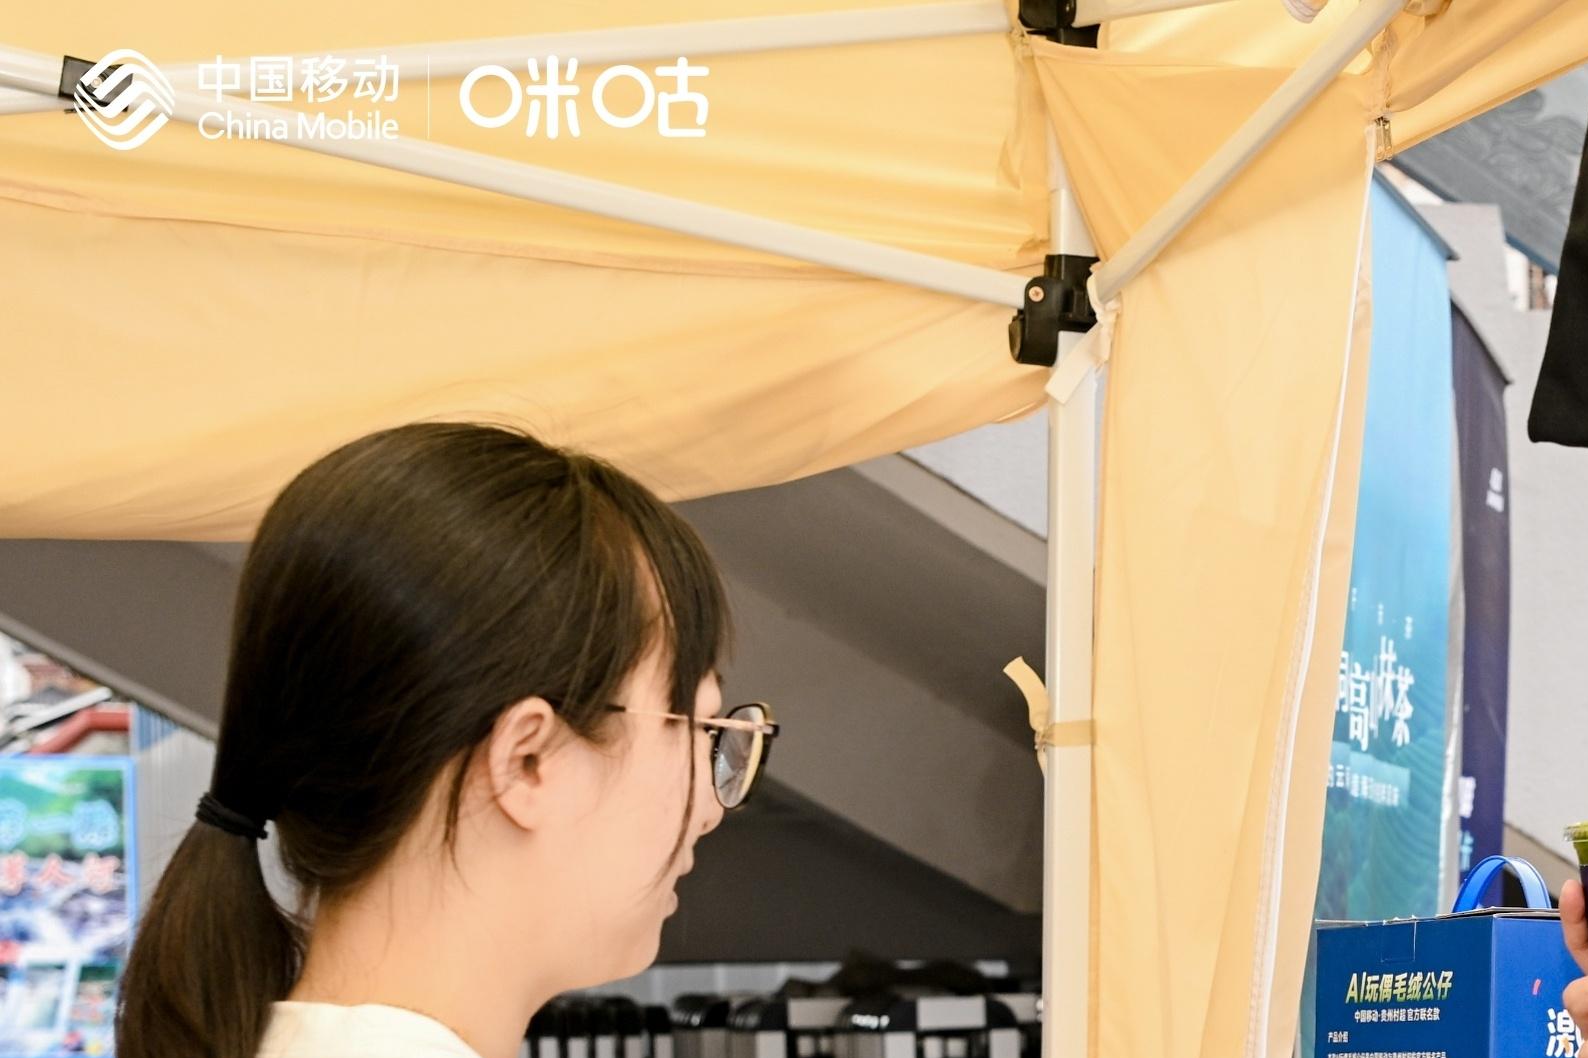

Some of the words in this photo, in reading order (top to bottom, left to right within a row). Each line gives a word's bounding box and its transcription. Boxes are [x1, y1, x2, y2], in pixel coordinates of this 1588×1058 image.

[1345, 970, 1454, 1004] AI玩偶毛绒公仔
